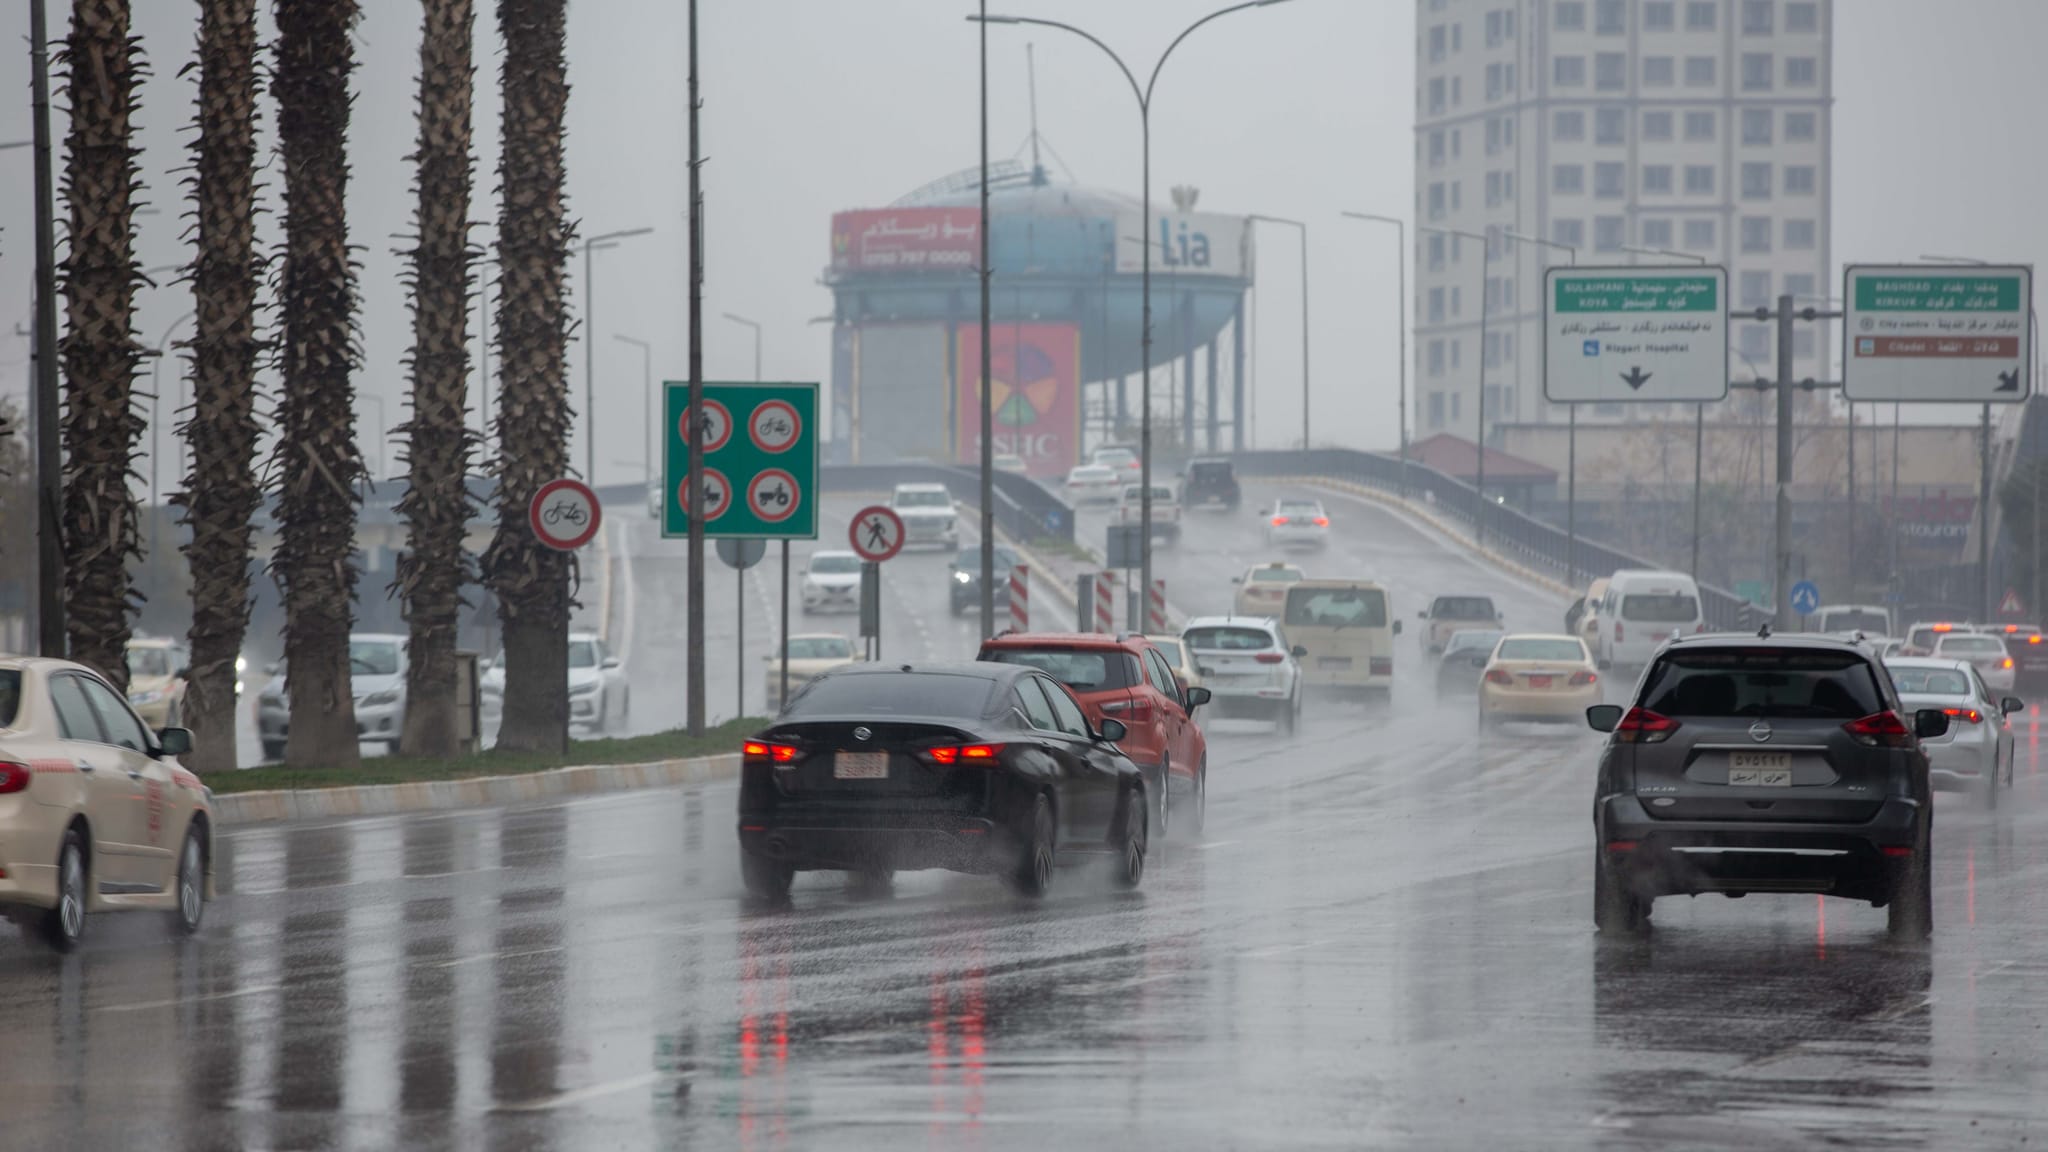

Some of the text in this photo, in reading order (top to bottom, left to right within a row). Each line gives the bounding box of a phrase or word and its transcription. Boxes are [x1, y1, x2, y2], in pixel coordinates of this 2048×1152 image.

[1160, 216, 1211, 267] Lia
[1564, 282, 1626, 293] SULAIMANI
[1876, 281, 1931, 292] BAGHDAD
[1579, 298, 1609, 308] KOYA
[1876, 297, 1917, 307] KIRKUK
[1888, 341, 1926, 352] Citadel
